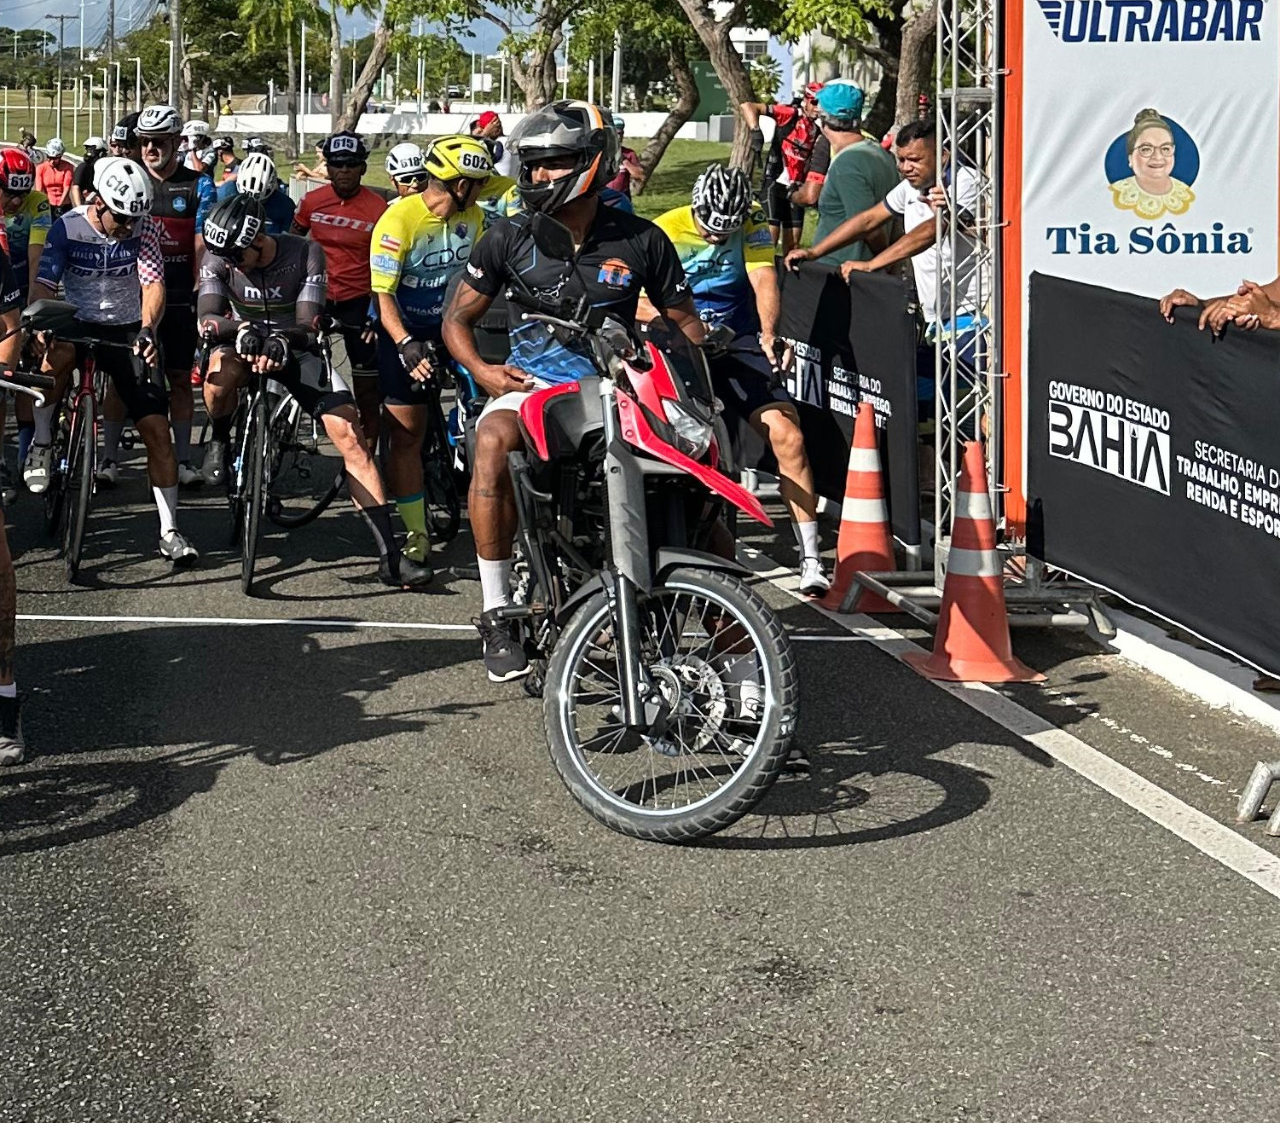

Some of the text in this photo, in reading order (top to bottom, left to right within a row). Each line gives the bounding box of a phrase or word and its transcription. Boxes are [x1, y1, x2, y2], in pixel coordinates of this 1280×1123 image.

[332, 137, 355, 148] 615
[462, 152, 487, 168] 602
[10, 176, 31, 188] 612
[129, 198, 150, 213] 614
[1046, 222, 1252, 254] Tia Sônia
[870, 378, 881, 394] DO
[1049, 380, 1170, 431] GOVERNO DO ESTADO
[1049, 400, 1171, 496] BAHIA
[1194, 440, 1266, 484] SECRETARIA
[1176, 455, 1280, 514] TRABALHO, EMPR
[1186, 481, 1228, 514] RENDA
[1230, 499, 1238, 519] E
